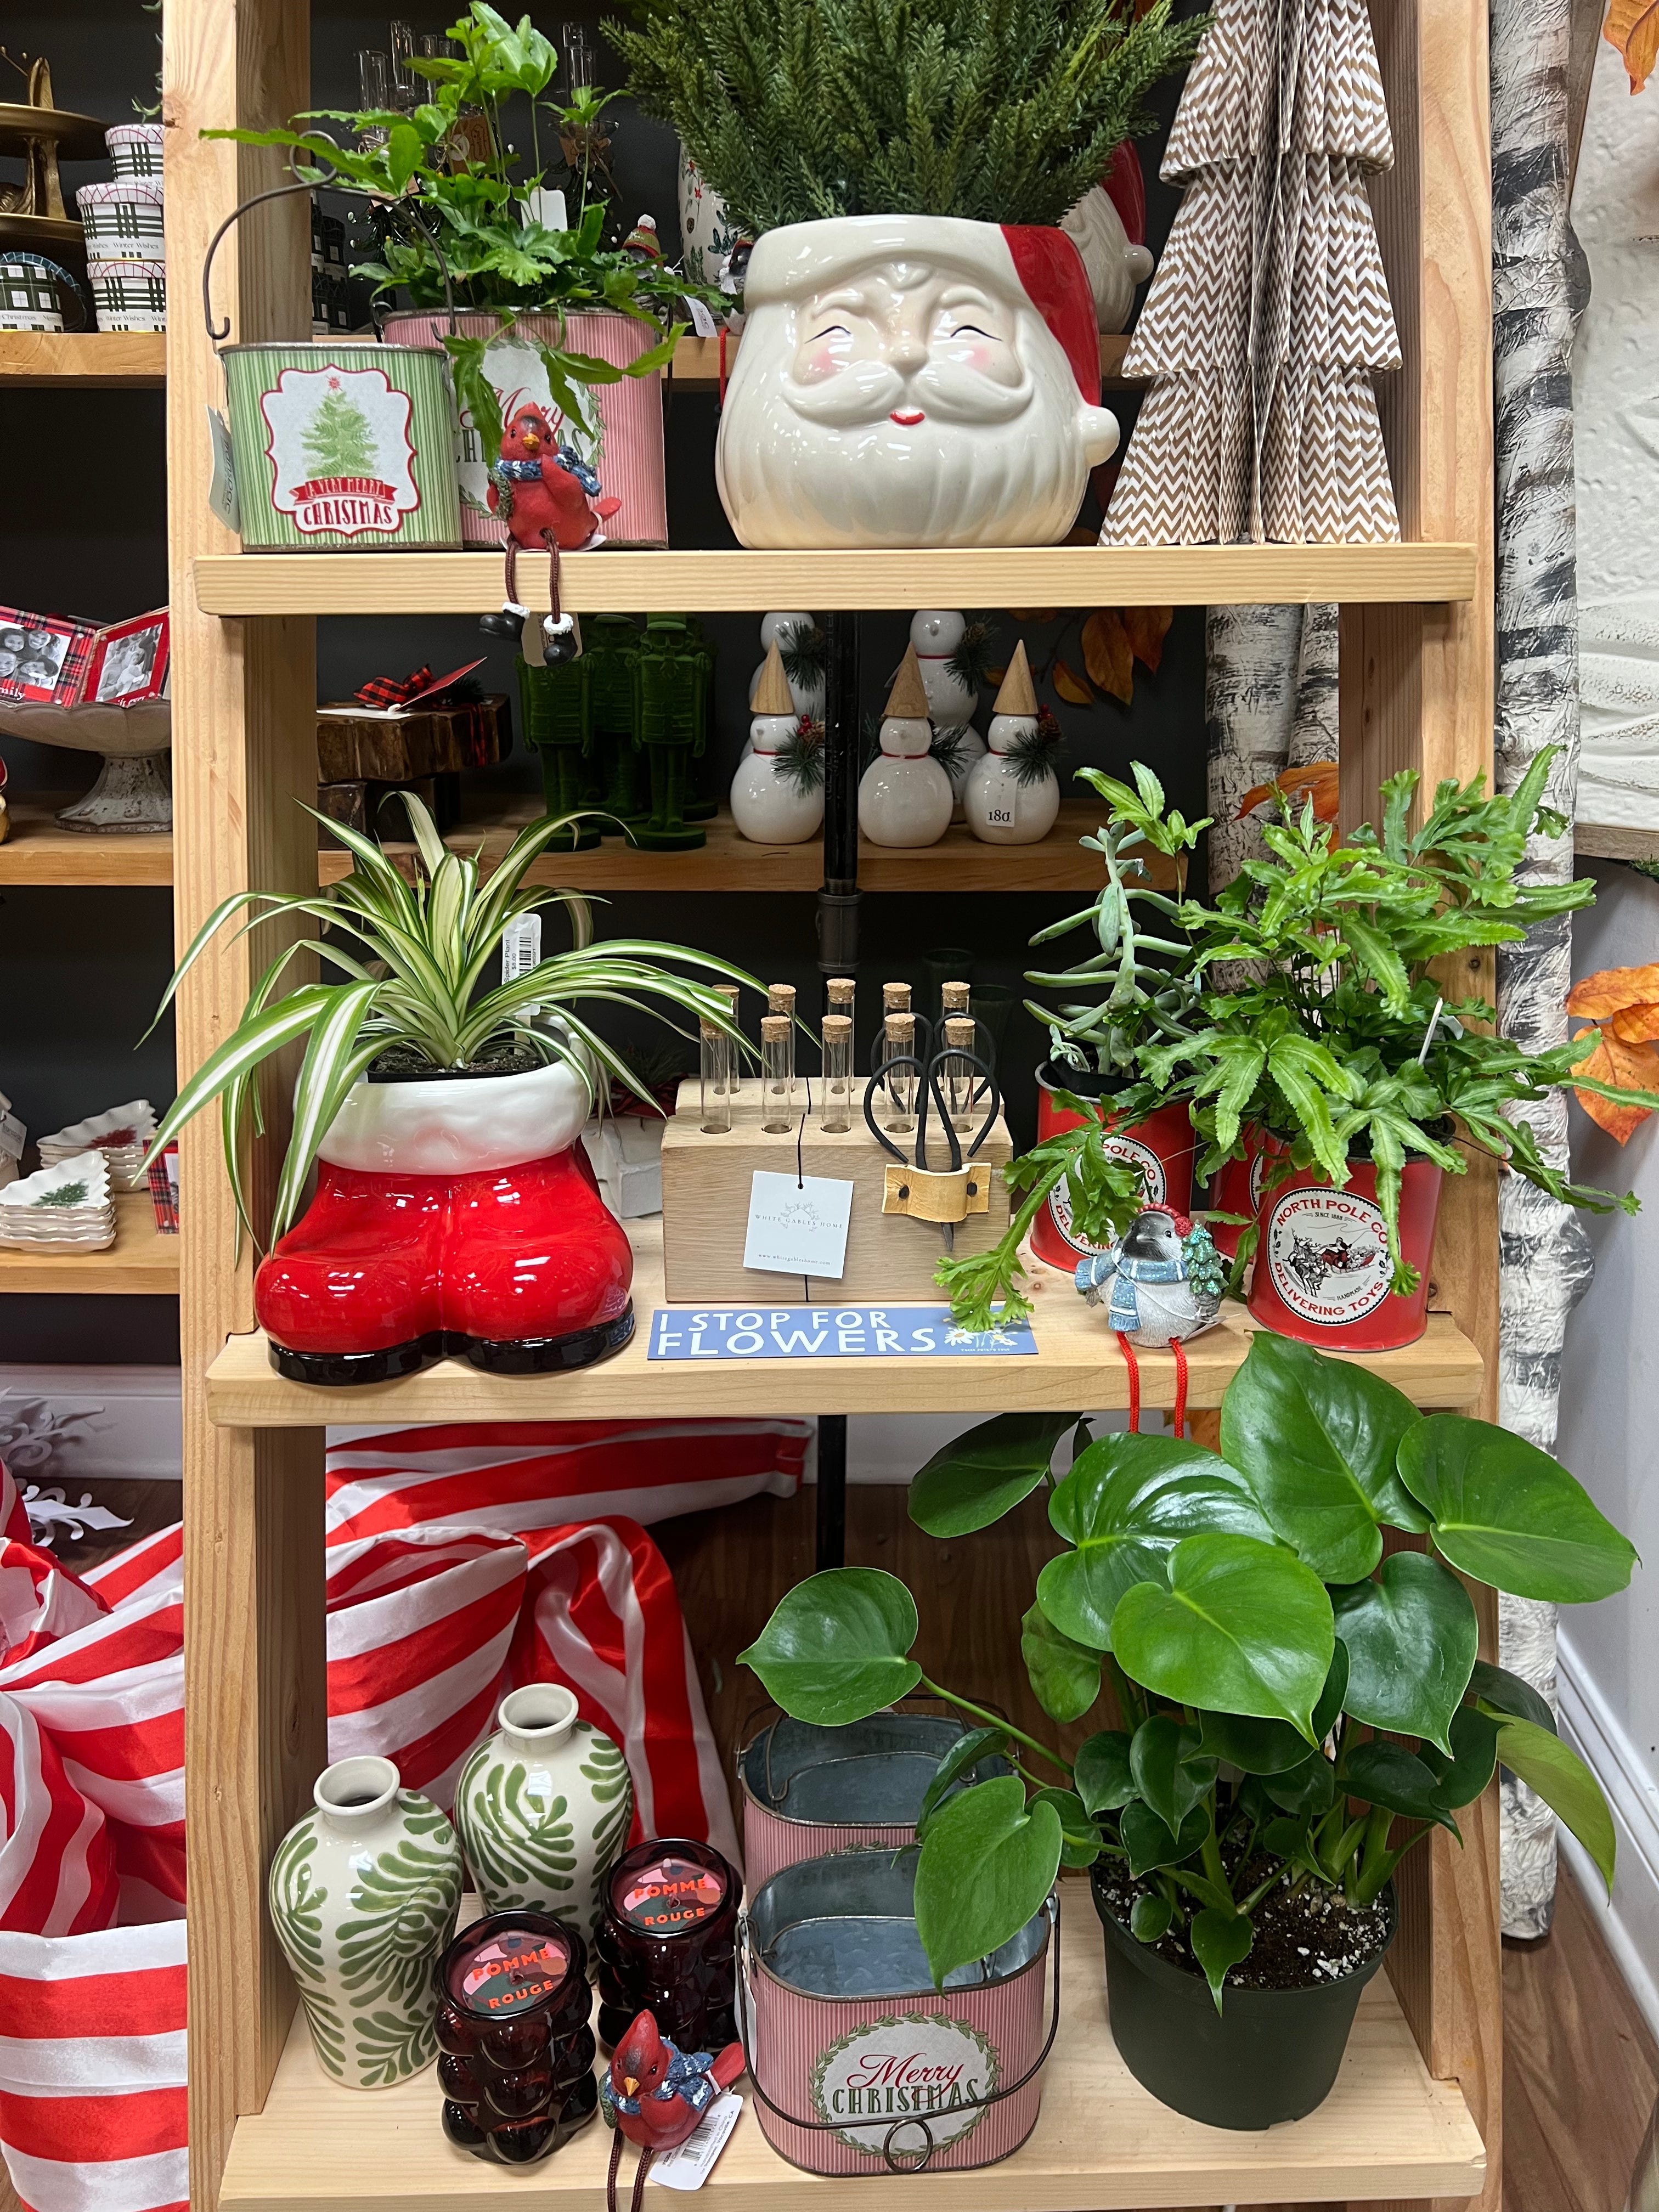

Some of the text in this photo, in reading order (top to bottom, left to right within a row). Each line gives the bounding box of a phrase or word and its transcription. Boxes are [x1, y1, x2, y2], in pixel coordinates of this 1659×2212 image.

[307, 477, 382, 497] A VERY MERRY
[303, 500, 393, 525] CHRISTMAS
[755, 1214, 781, 1222] WHITE
[1277, 1199, 1321, 1227] NORTH
[1325, 1200, 1372, 1223] POLE
[1274, 1262, 1384, 1316] DELIVERING TOYS
[660, 1311, 891, 1331] I STOP FOR
[658, 1328, 936, 1356] FLOWERS
[634, 1878, 708, 1899] POMME
[644, 1908, 705, 1926] ROUGE
[472, 1947, 551, 1980] POMME
[488, 1980, 554, 2009] ROUGE
[847, 2053, 964, 2103] Merry
[832, 2079, 979, 2114] CHRISTMAS
